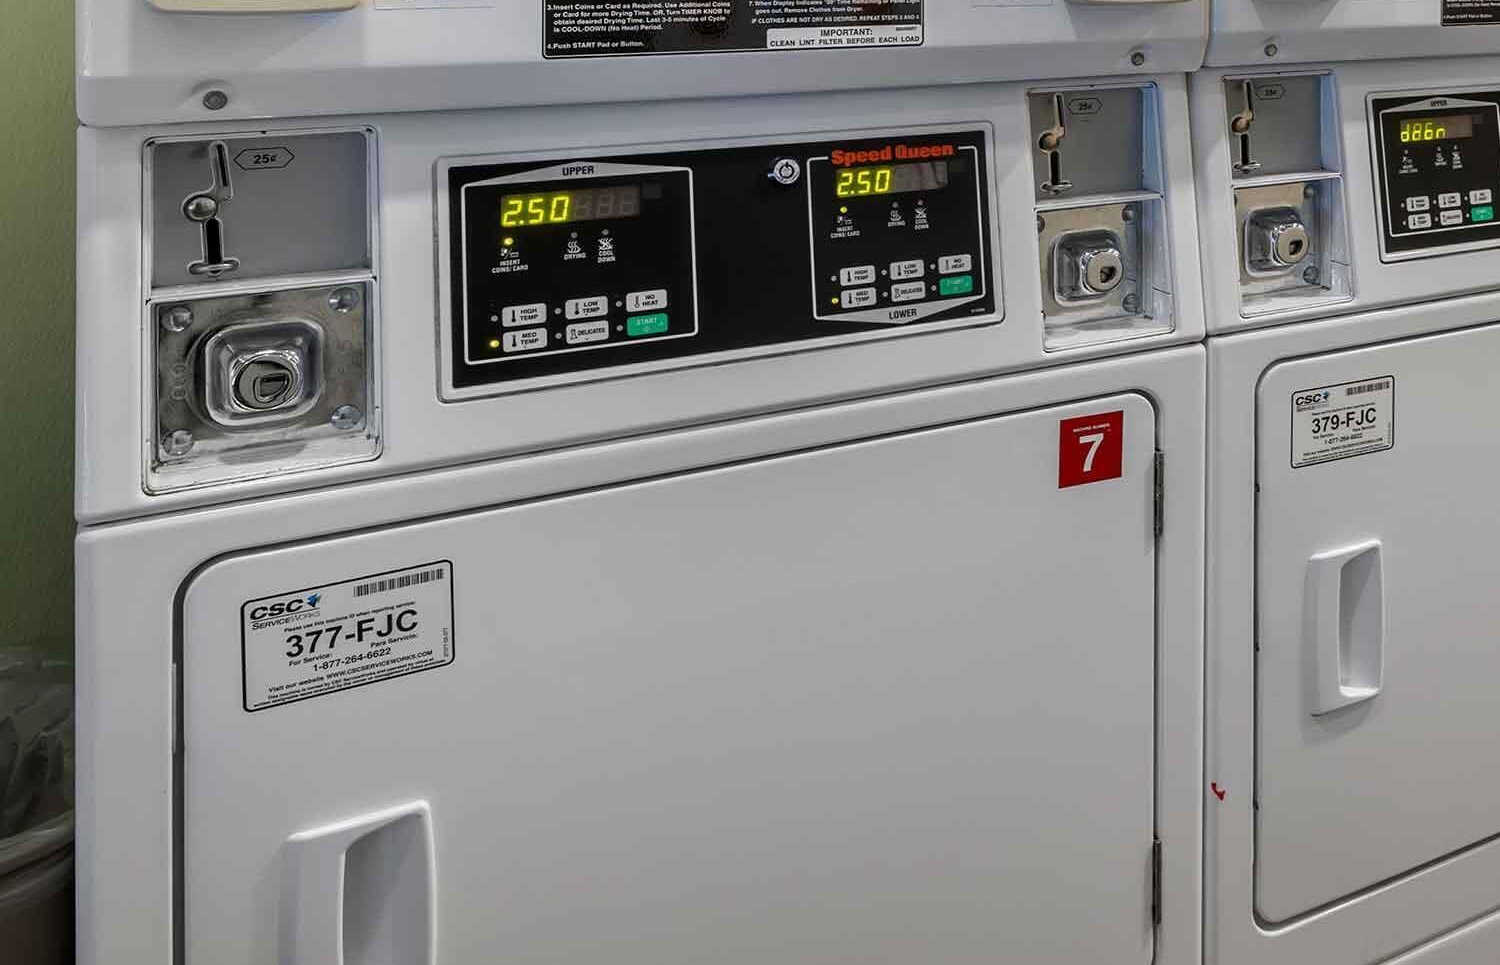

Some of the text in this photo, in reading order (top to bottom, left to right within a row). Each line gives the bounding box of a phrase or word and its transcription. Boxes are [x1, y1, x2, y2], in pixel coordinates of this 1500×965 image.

[610, 10, 633, 18] Drying
[820, 28, 873, 37] IMPORTANT:
[253, 153, 277, 165] 25¢
[831, 144, 953, 166] Speed Queen
[562, 165, 595, 176] UPPER
[837, 169, 890, 196] 2.50
[501, 195, 570, 227] 2.50
[888, 308, 917, 319] LOWER
[1295, 393, 1322, 406] CSC
[1311, 407, 1377, 434] 379-FJC
[1079, 433, 1104, 473] 7
[250, 598, 304, 621] CSC
[286, 609, 418, 657] 377-FJC
[313, 647, 391, 672] 1-877-264-6622
